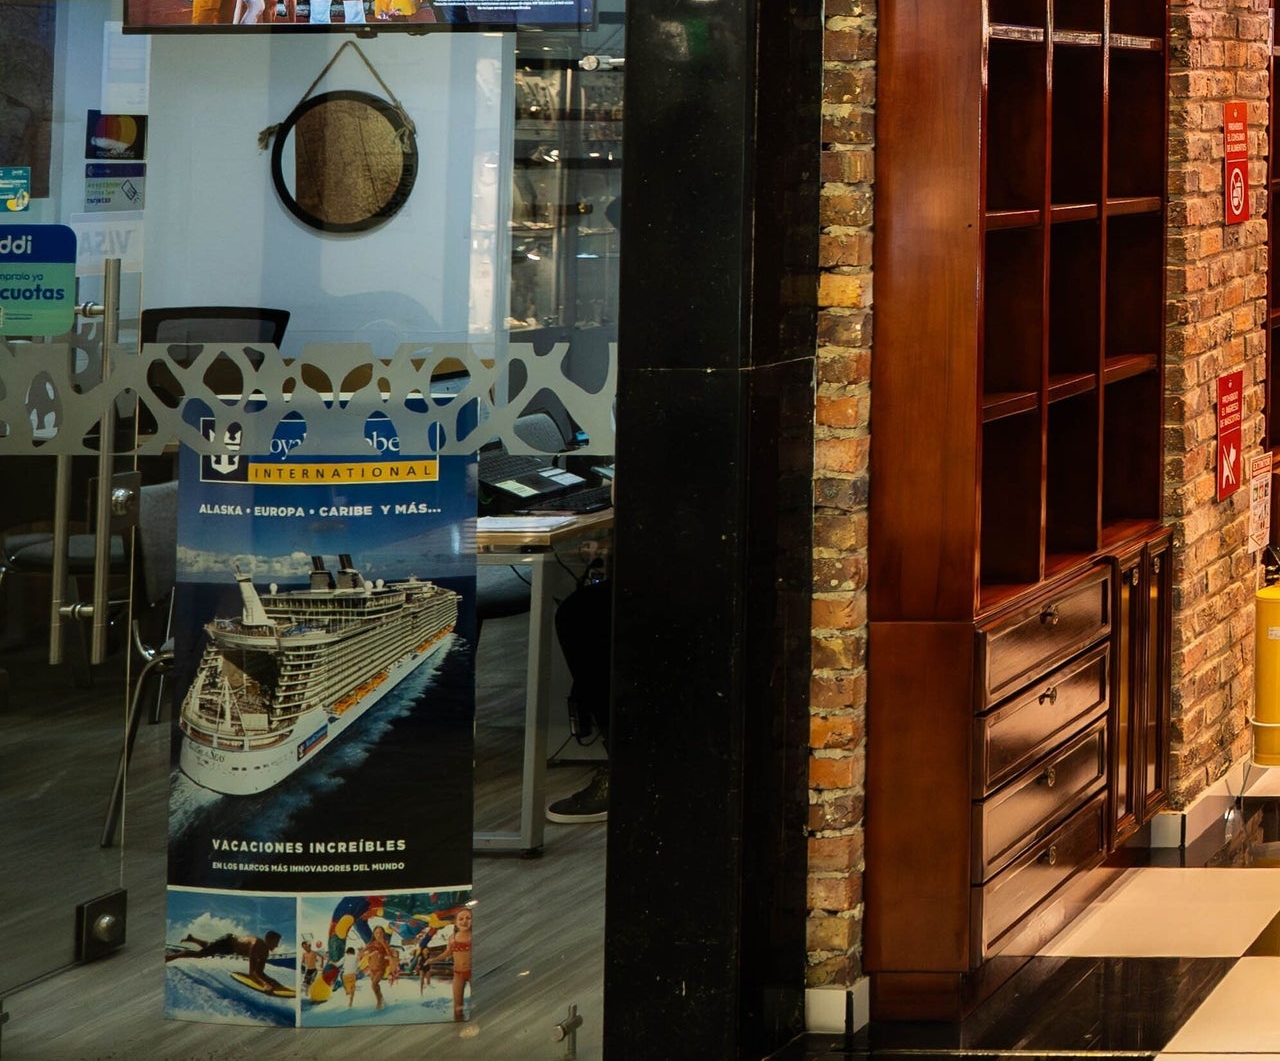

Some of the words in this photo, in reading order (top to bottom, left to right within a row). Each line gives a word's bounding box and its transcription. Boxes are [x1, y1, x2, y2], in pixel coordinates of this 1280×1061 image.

[33, 273, 44, 282] ya
[1, 283, 65, 301] cuotas
[253, 465, 432, 480] INTERNATIONAL
[199, 503, 243, 516] ALASKA
[254, 506, 305, 517] EUROPA
[319, 505, 373, 517] CARIBE
[381, 505, 390, 515] Y
[395, 501, 442, 515] MÁS...
[212, 838, 303, 853] VACACIONES
[309, 838, 407, 853] INCREÍBLES
[212, 861, 222, 869] EN
[223, 862, 238, 870] LOS
[239, 863, 270, 871] BARCOS
[271, 861, 288, 872] MÁS
[289, 864, 351, 873] INNOVADORES
[353, 863, 370, 871] DEL
[371, 861, 405, 871] MUNDO
